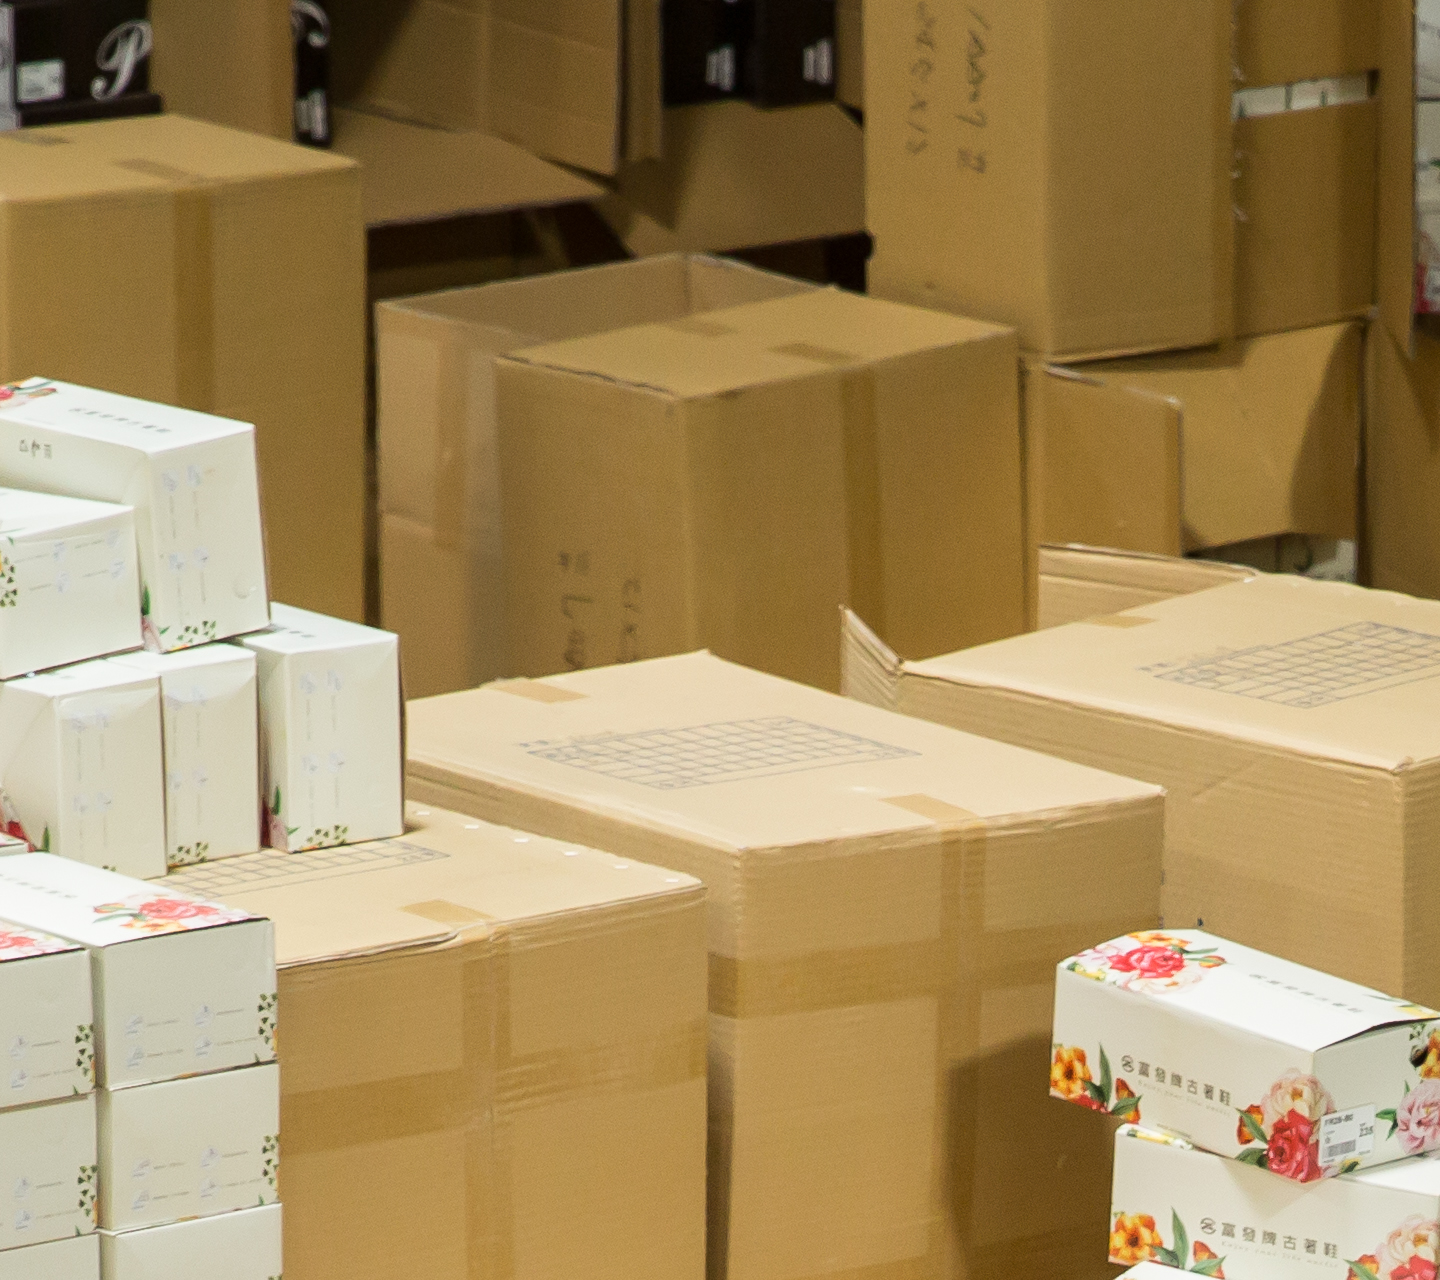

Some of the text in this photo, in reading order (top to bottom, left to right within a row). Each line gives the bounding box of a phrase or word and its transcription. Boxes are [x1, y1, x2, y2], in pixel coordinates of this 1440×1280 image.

[1138, 1061, 1232, 1107] 富發牌古著鞋
[1221, 1222, 1338, 1260] 富發牌古著鞋
